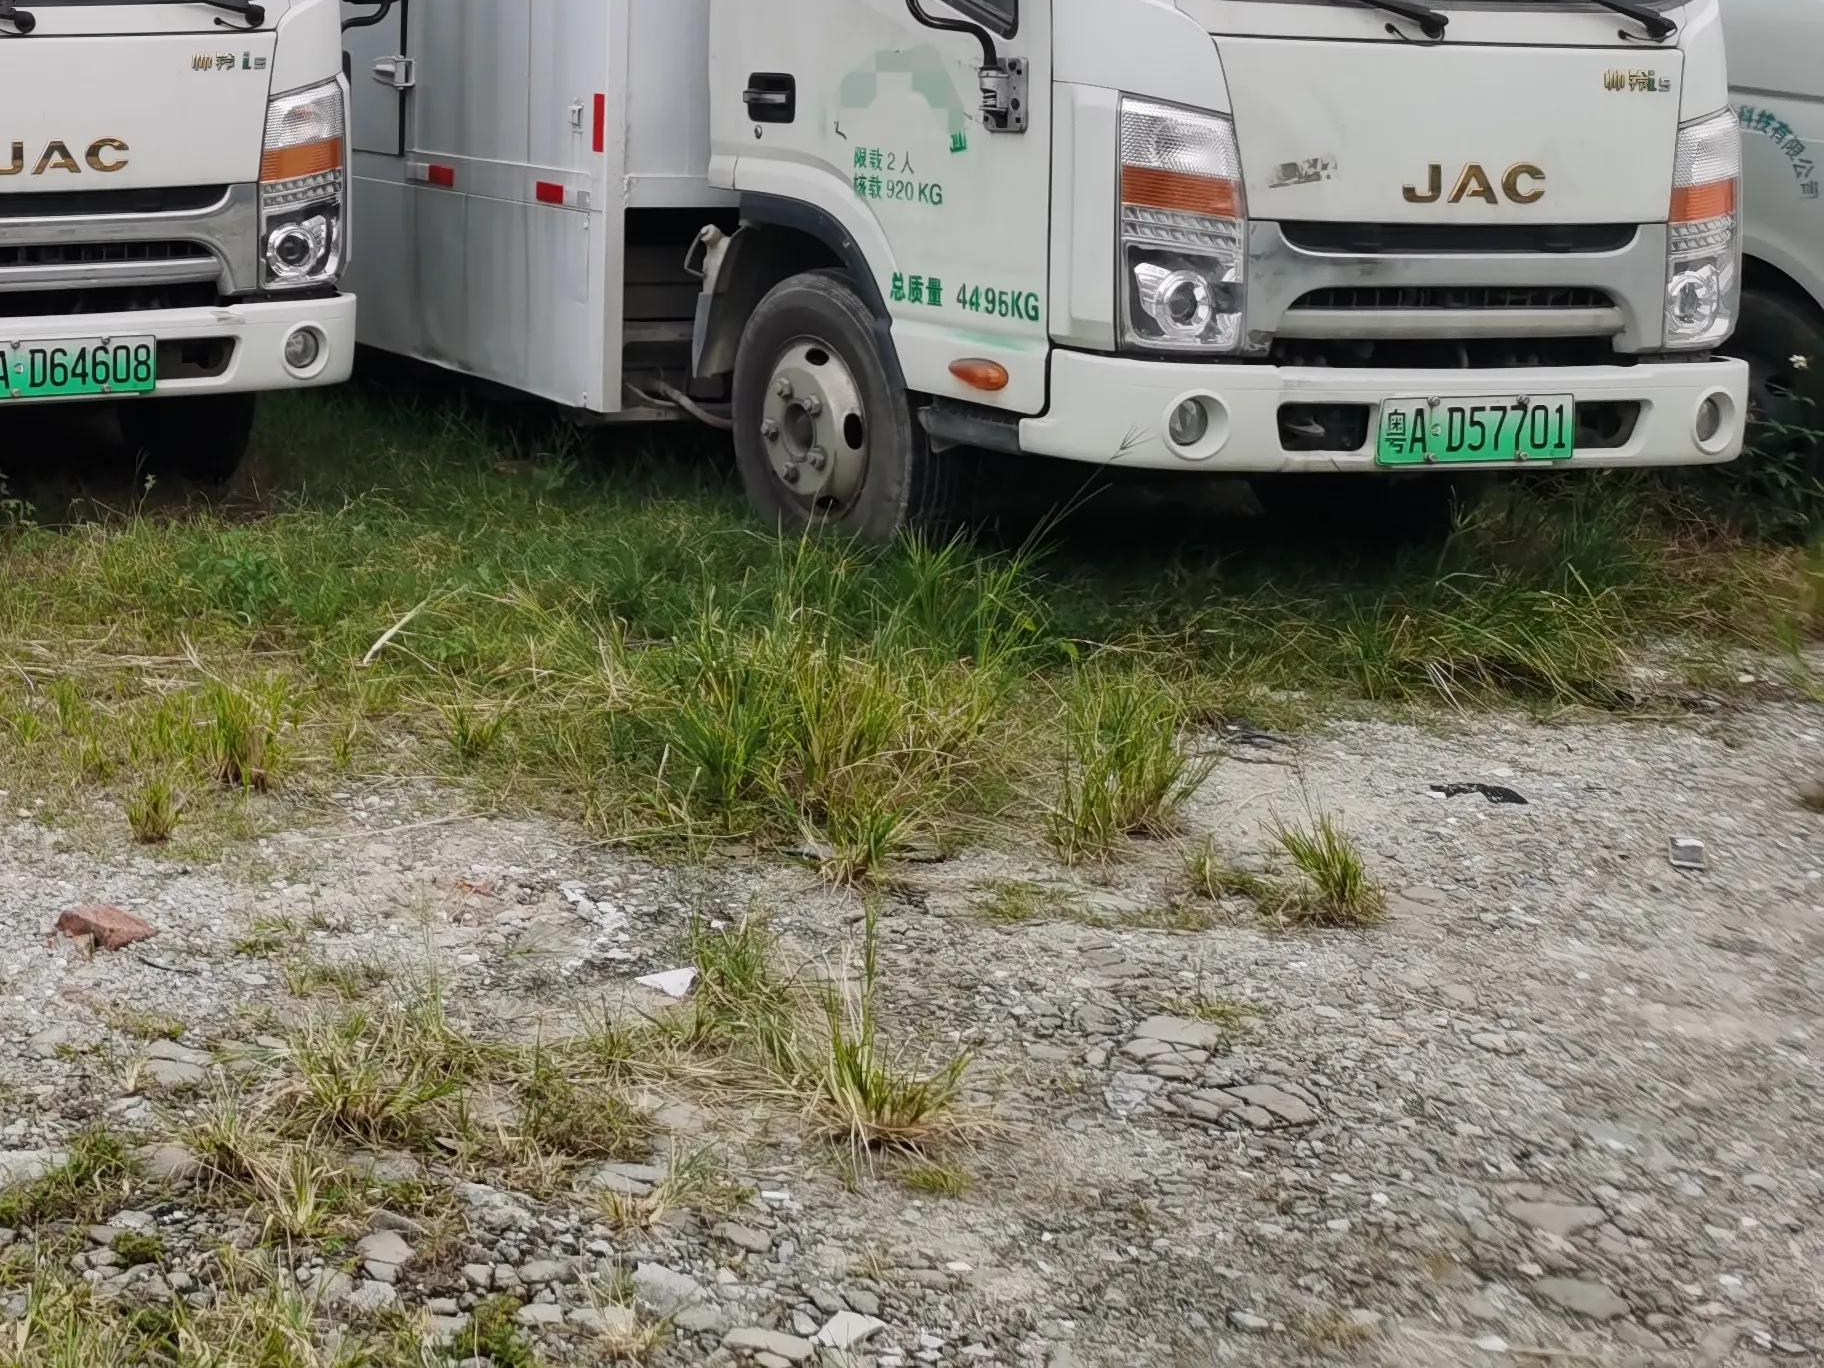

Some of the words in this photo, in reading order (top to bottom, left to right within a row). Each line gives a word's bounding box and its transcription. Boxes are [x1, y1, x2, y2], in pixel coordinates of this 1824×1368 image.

[1402, 162, 1546, 205] JAC
[890, 271, 943, 307] 总质量
